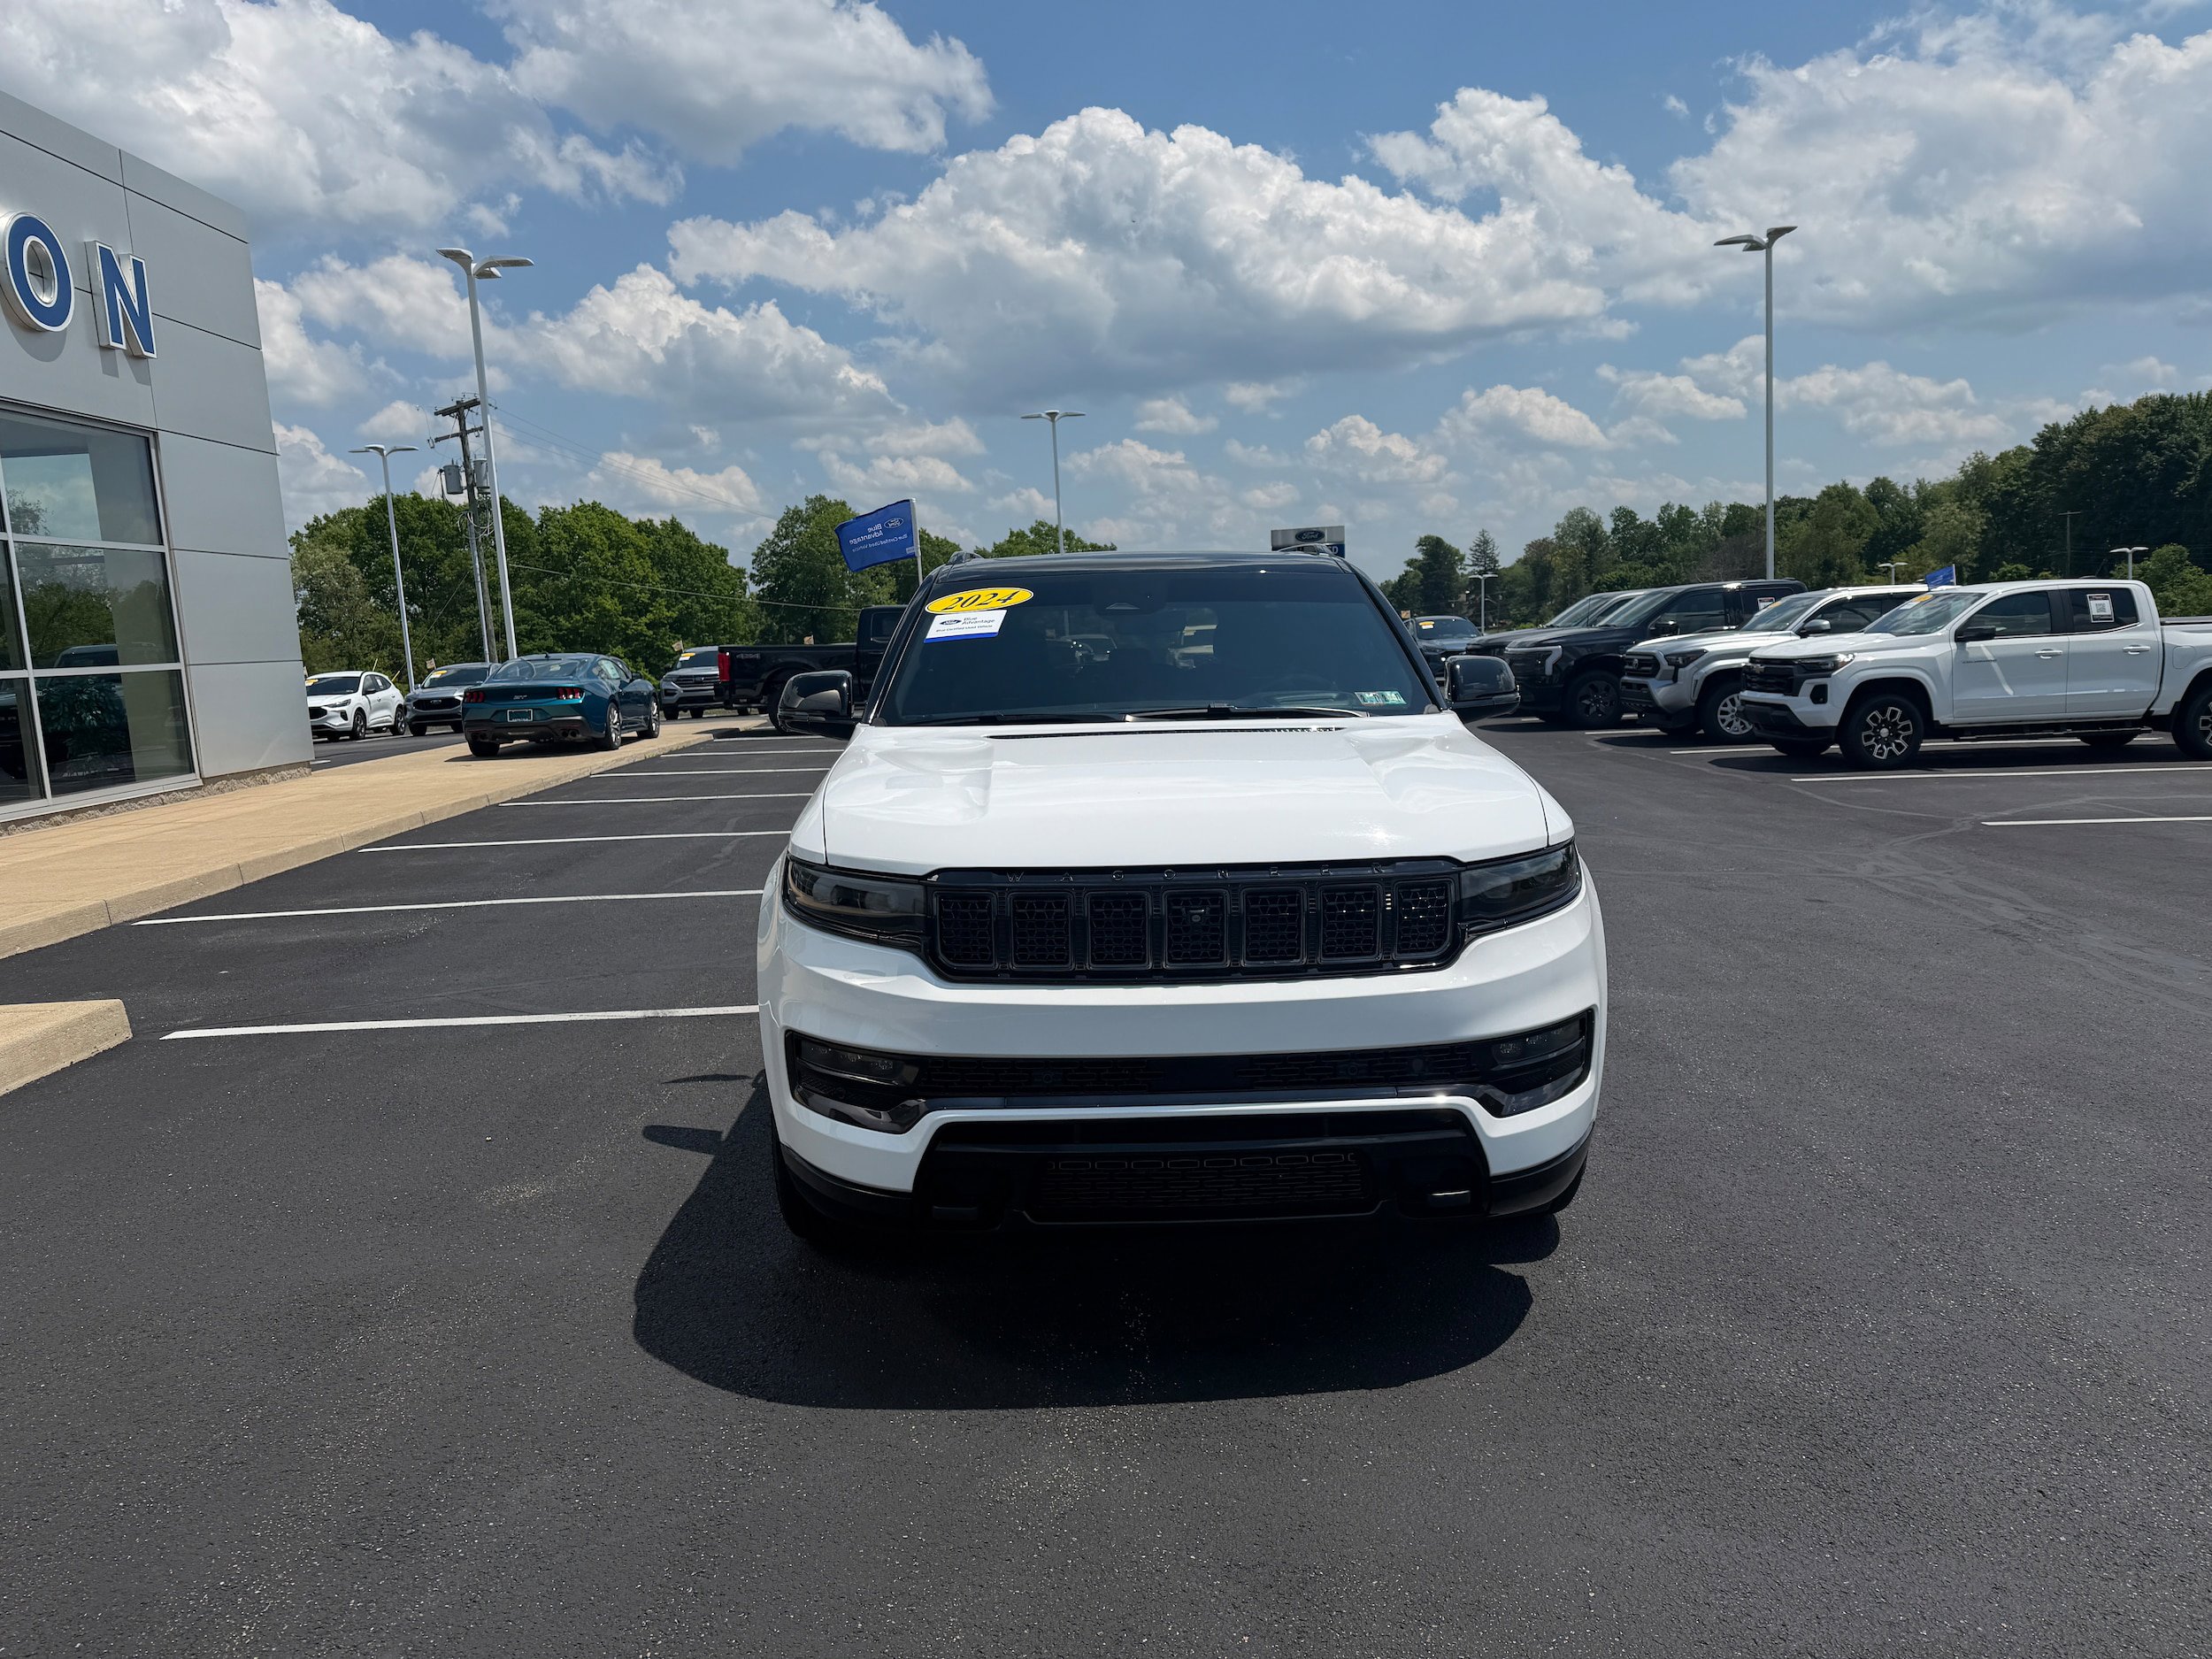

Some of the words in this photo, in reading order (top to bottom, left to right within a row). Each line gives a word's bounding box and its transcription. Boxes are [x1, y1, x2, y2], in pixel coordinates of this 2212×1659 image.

[1301, 531, 1319, 540] Ford
[941, 590, 1020, 611] 2024
[1006, 862, 1386, 883] WAGONEER
